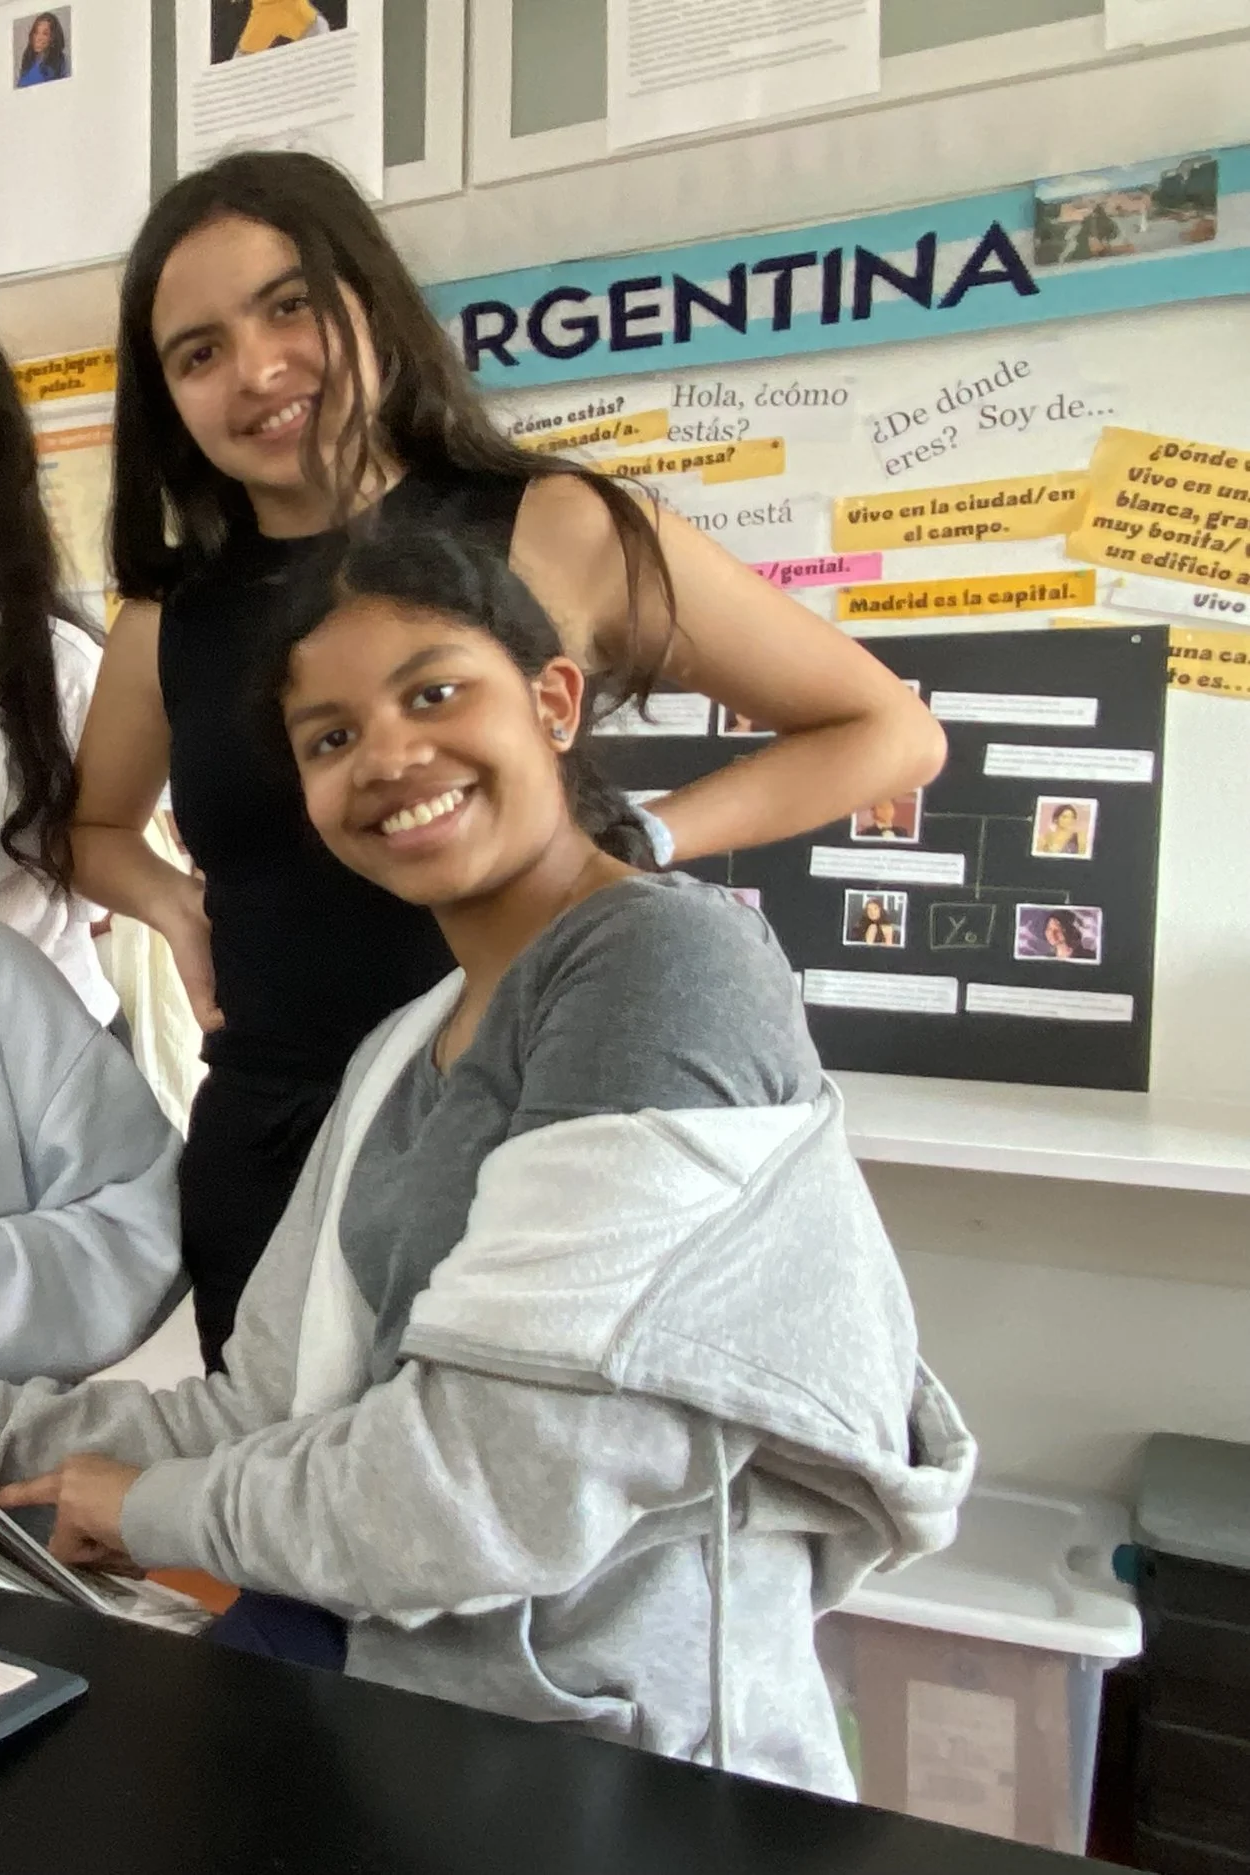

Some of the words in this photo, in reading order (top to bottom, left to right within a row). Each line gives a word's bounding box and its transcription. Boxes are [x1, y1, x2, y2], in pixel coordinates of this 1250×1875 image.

[460, 219, 1040, 372] RGENTINA
[567, 395, 625, 422] estás?
[671, 383, 745, 410] Hola,
[754, 382, 849, 410] ¿cómo
[873, 407, 930, 444] ¿De
[936, 360, 1031, 415] dónde
[978, 403, 1037, 432] Soy
[1046, 394, 1115, 421] de...
[666, 418, 750, 443] estás?
[657, 457, 676, 472] te
[681, 446, 736, 472] pasa?
[886, 426, 958, 476] eres?
[1149, 442, 1238, 469] ¿Dónde
[1128, 466, 1178, 488] Vivo
[1183, 479, 1212, 495] en
[1217, 484, 1250, 502] un
[736, 502, 793, 527] está
[848, 508, 893, 525] Vivo
[899, 503, 925, 518] en
[930, 499, 949, 515] la
[1116, 490, 1200, 524] blanca,
[903, 525, 922, 543] el
[927, 521, 1010, 541] campo.
[1092, 516, 1143, 540] muy
[1105, 544, 1136, 562] un
[1141, 552, 1232, 581] edificio
[849, 593, 928, 613] Madrid
[934, 594, 957, 608] es
[962, 589, 983, 606] la
[988, 583, 1076, 608] capital.
[1193, 592, 1247, 614] Vivo
[1219, 649, 1250, 665] ca
